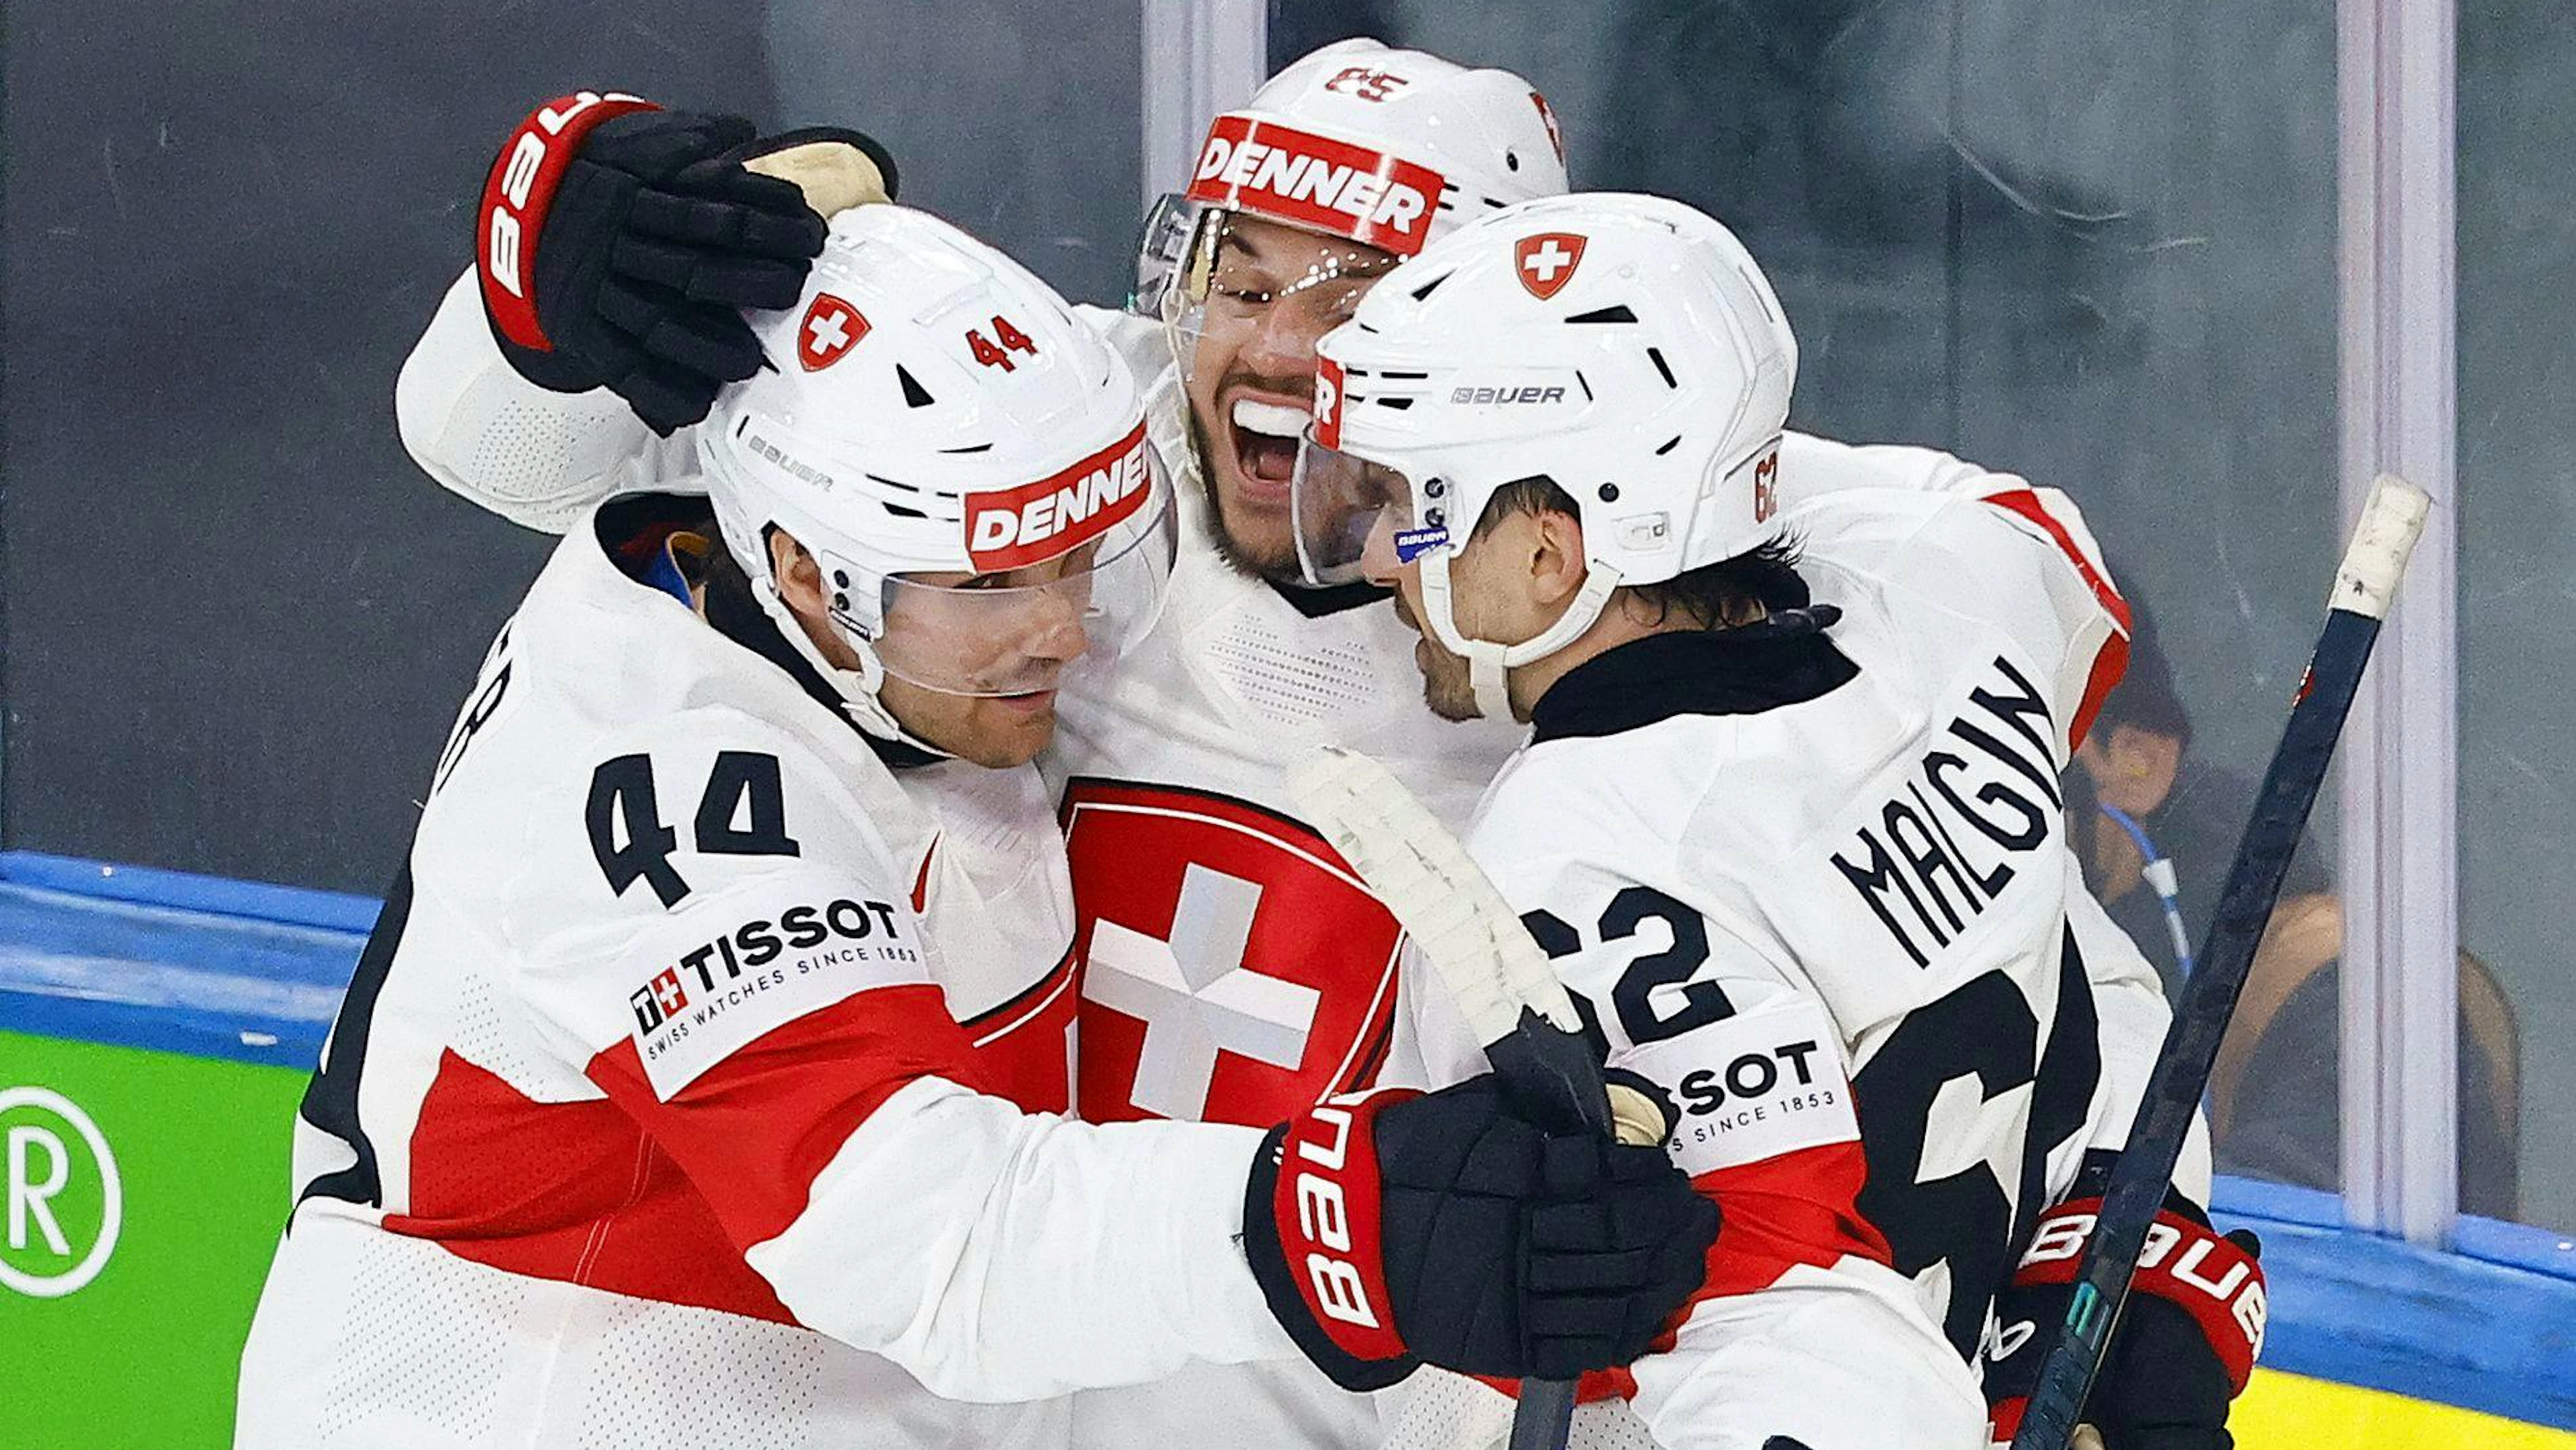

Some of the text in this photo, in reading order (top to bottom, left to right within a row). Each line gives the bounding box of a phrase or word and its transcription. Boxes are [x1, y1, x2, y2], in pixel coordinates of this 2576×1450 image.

[1197, 138, 1426, 235] DENNER
[965, 314, 1039, 373] 44
[970, 439, 1149, 552] DENNE
[586, 750, 801, 910] 44
[1830, 655, 2062, 970] MALGIN
[680, 898, 900, 993] TISSOT
[649, 1023, 690, 1060] SWISS
[694, 969, 785, 1026] WATCHES
[797, 947, 869, 975] SINCE
[1680, 1039, 1817, 1117] SOT
[1694, 1106, 1766, 1143] SINCE
[1780, 1090, 1835, 1113] 1853
